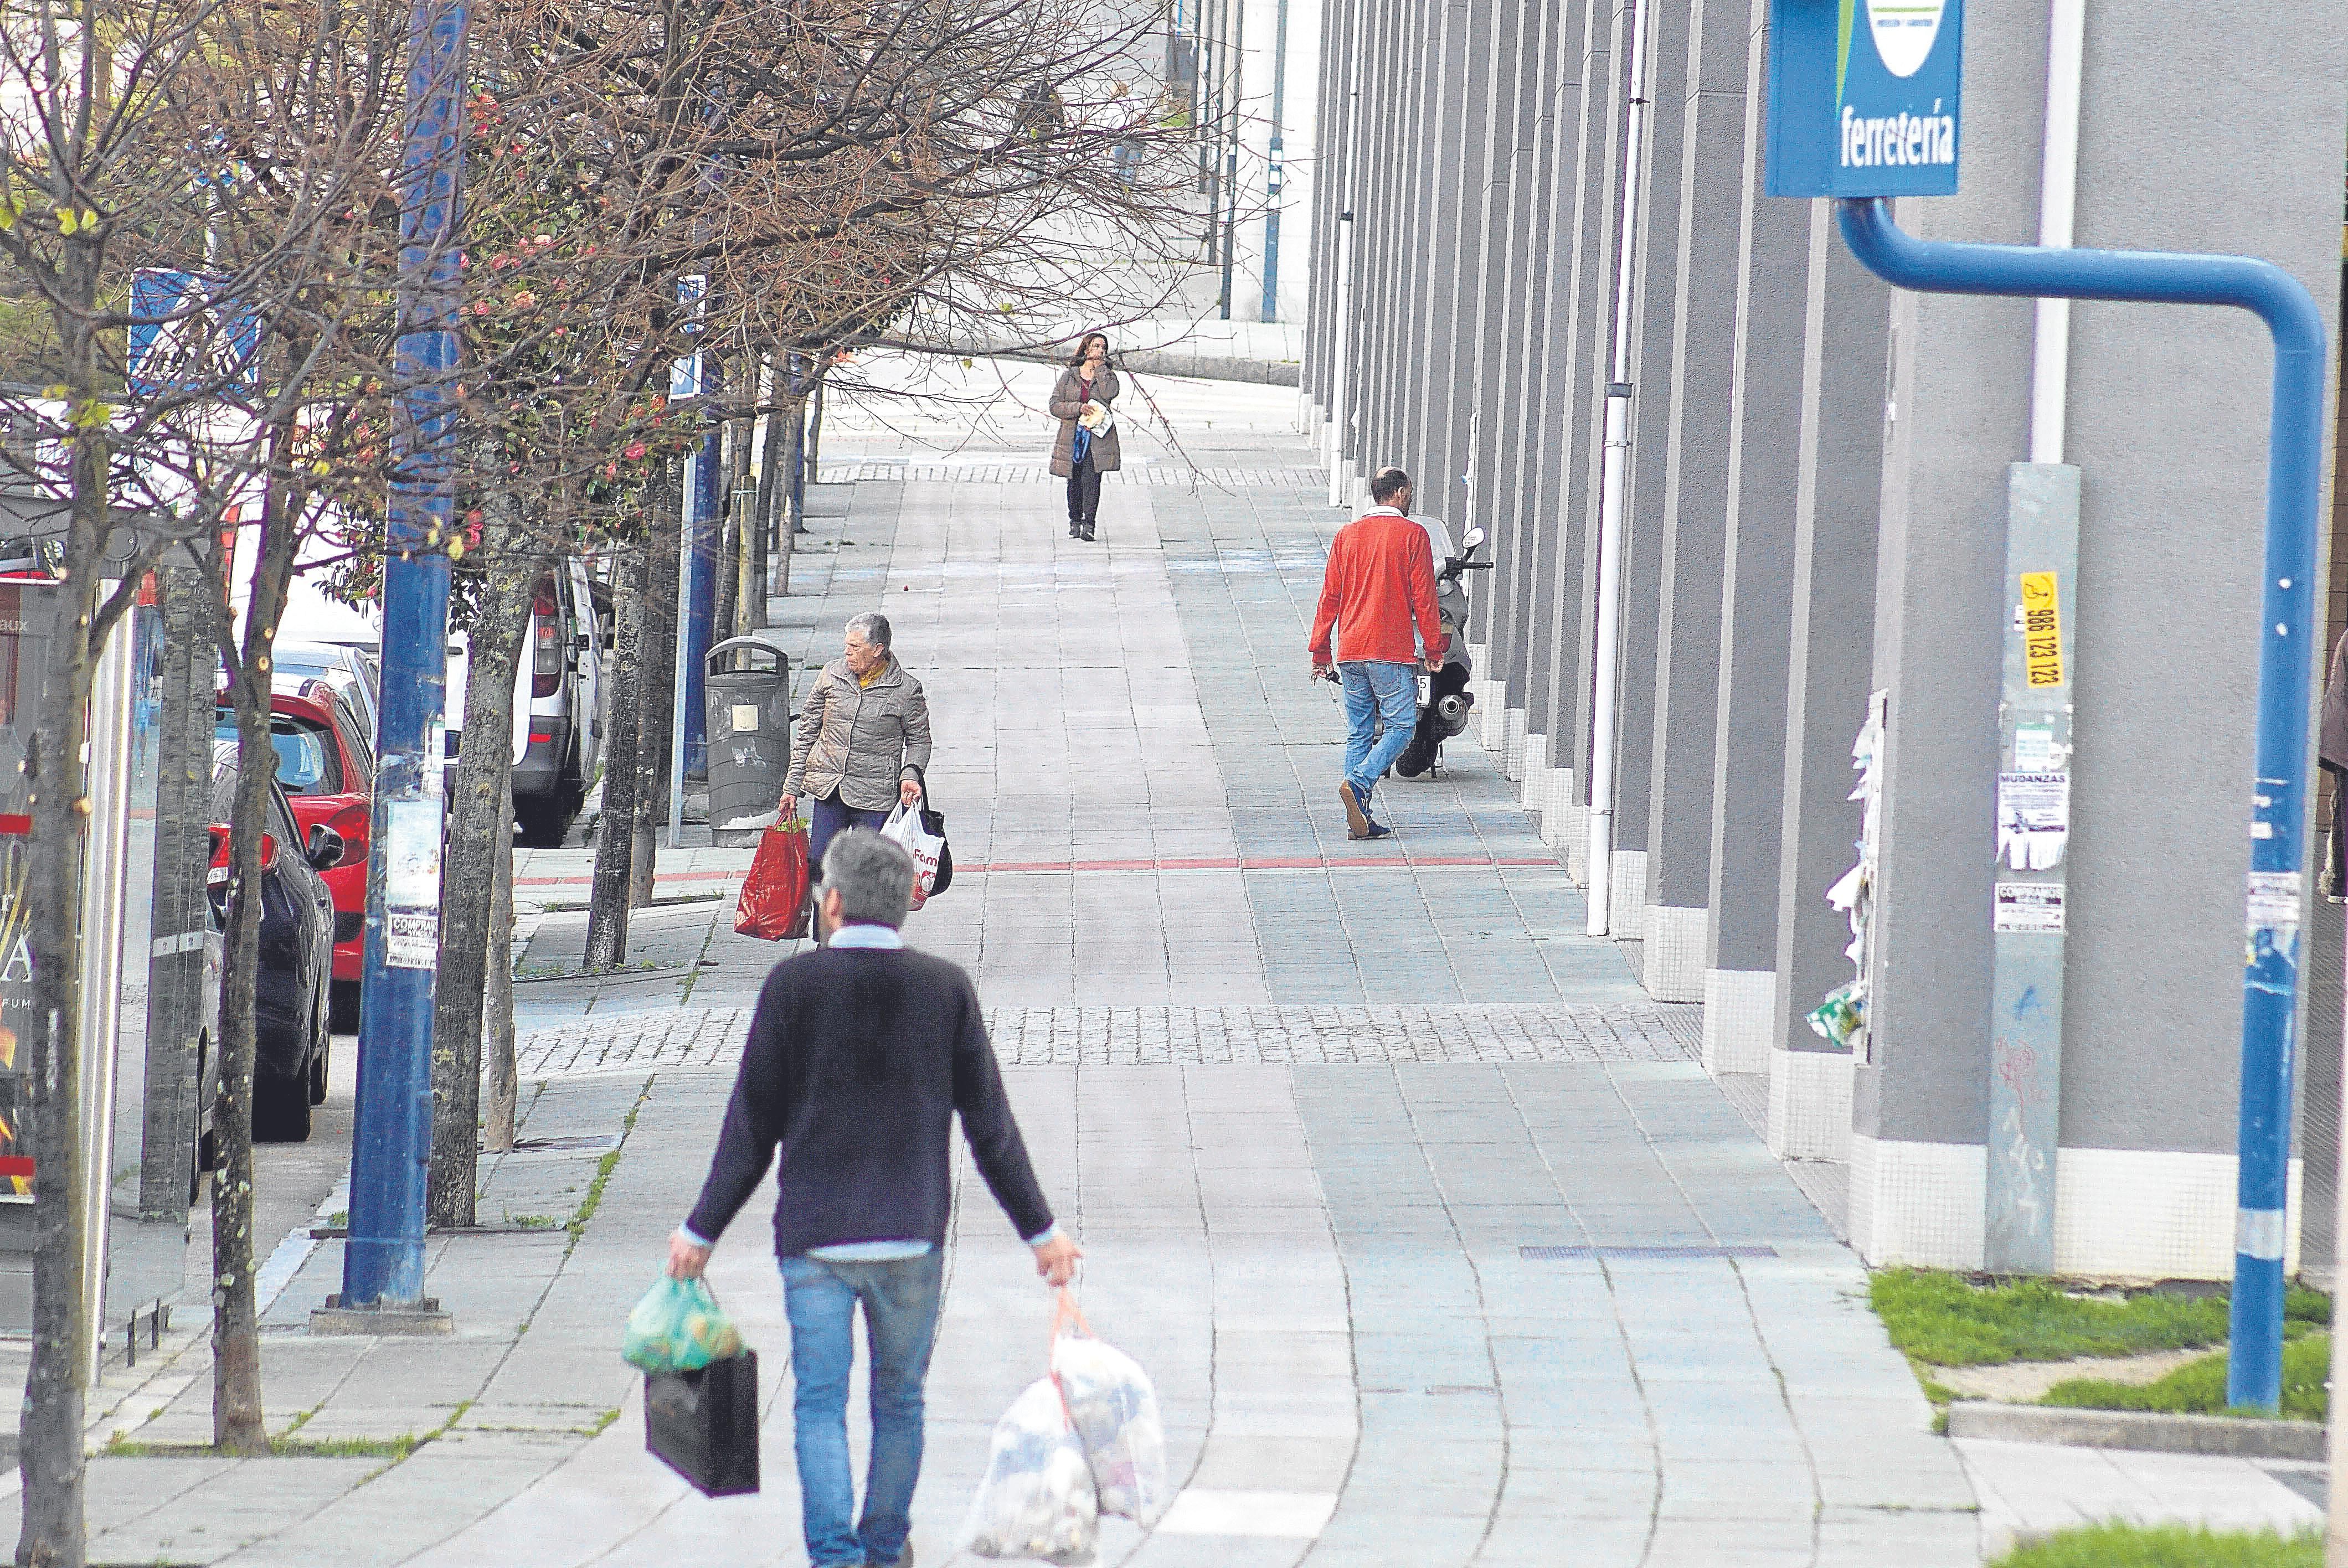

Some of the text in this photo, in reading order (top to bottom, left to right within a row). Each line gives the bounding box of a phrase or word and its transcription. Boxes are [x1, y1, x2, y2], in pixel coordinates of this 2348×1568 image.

[1841, 98, 1954, 167] ferretería
[2027, 610, 2059, 684] 986 123 123
